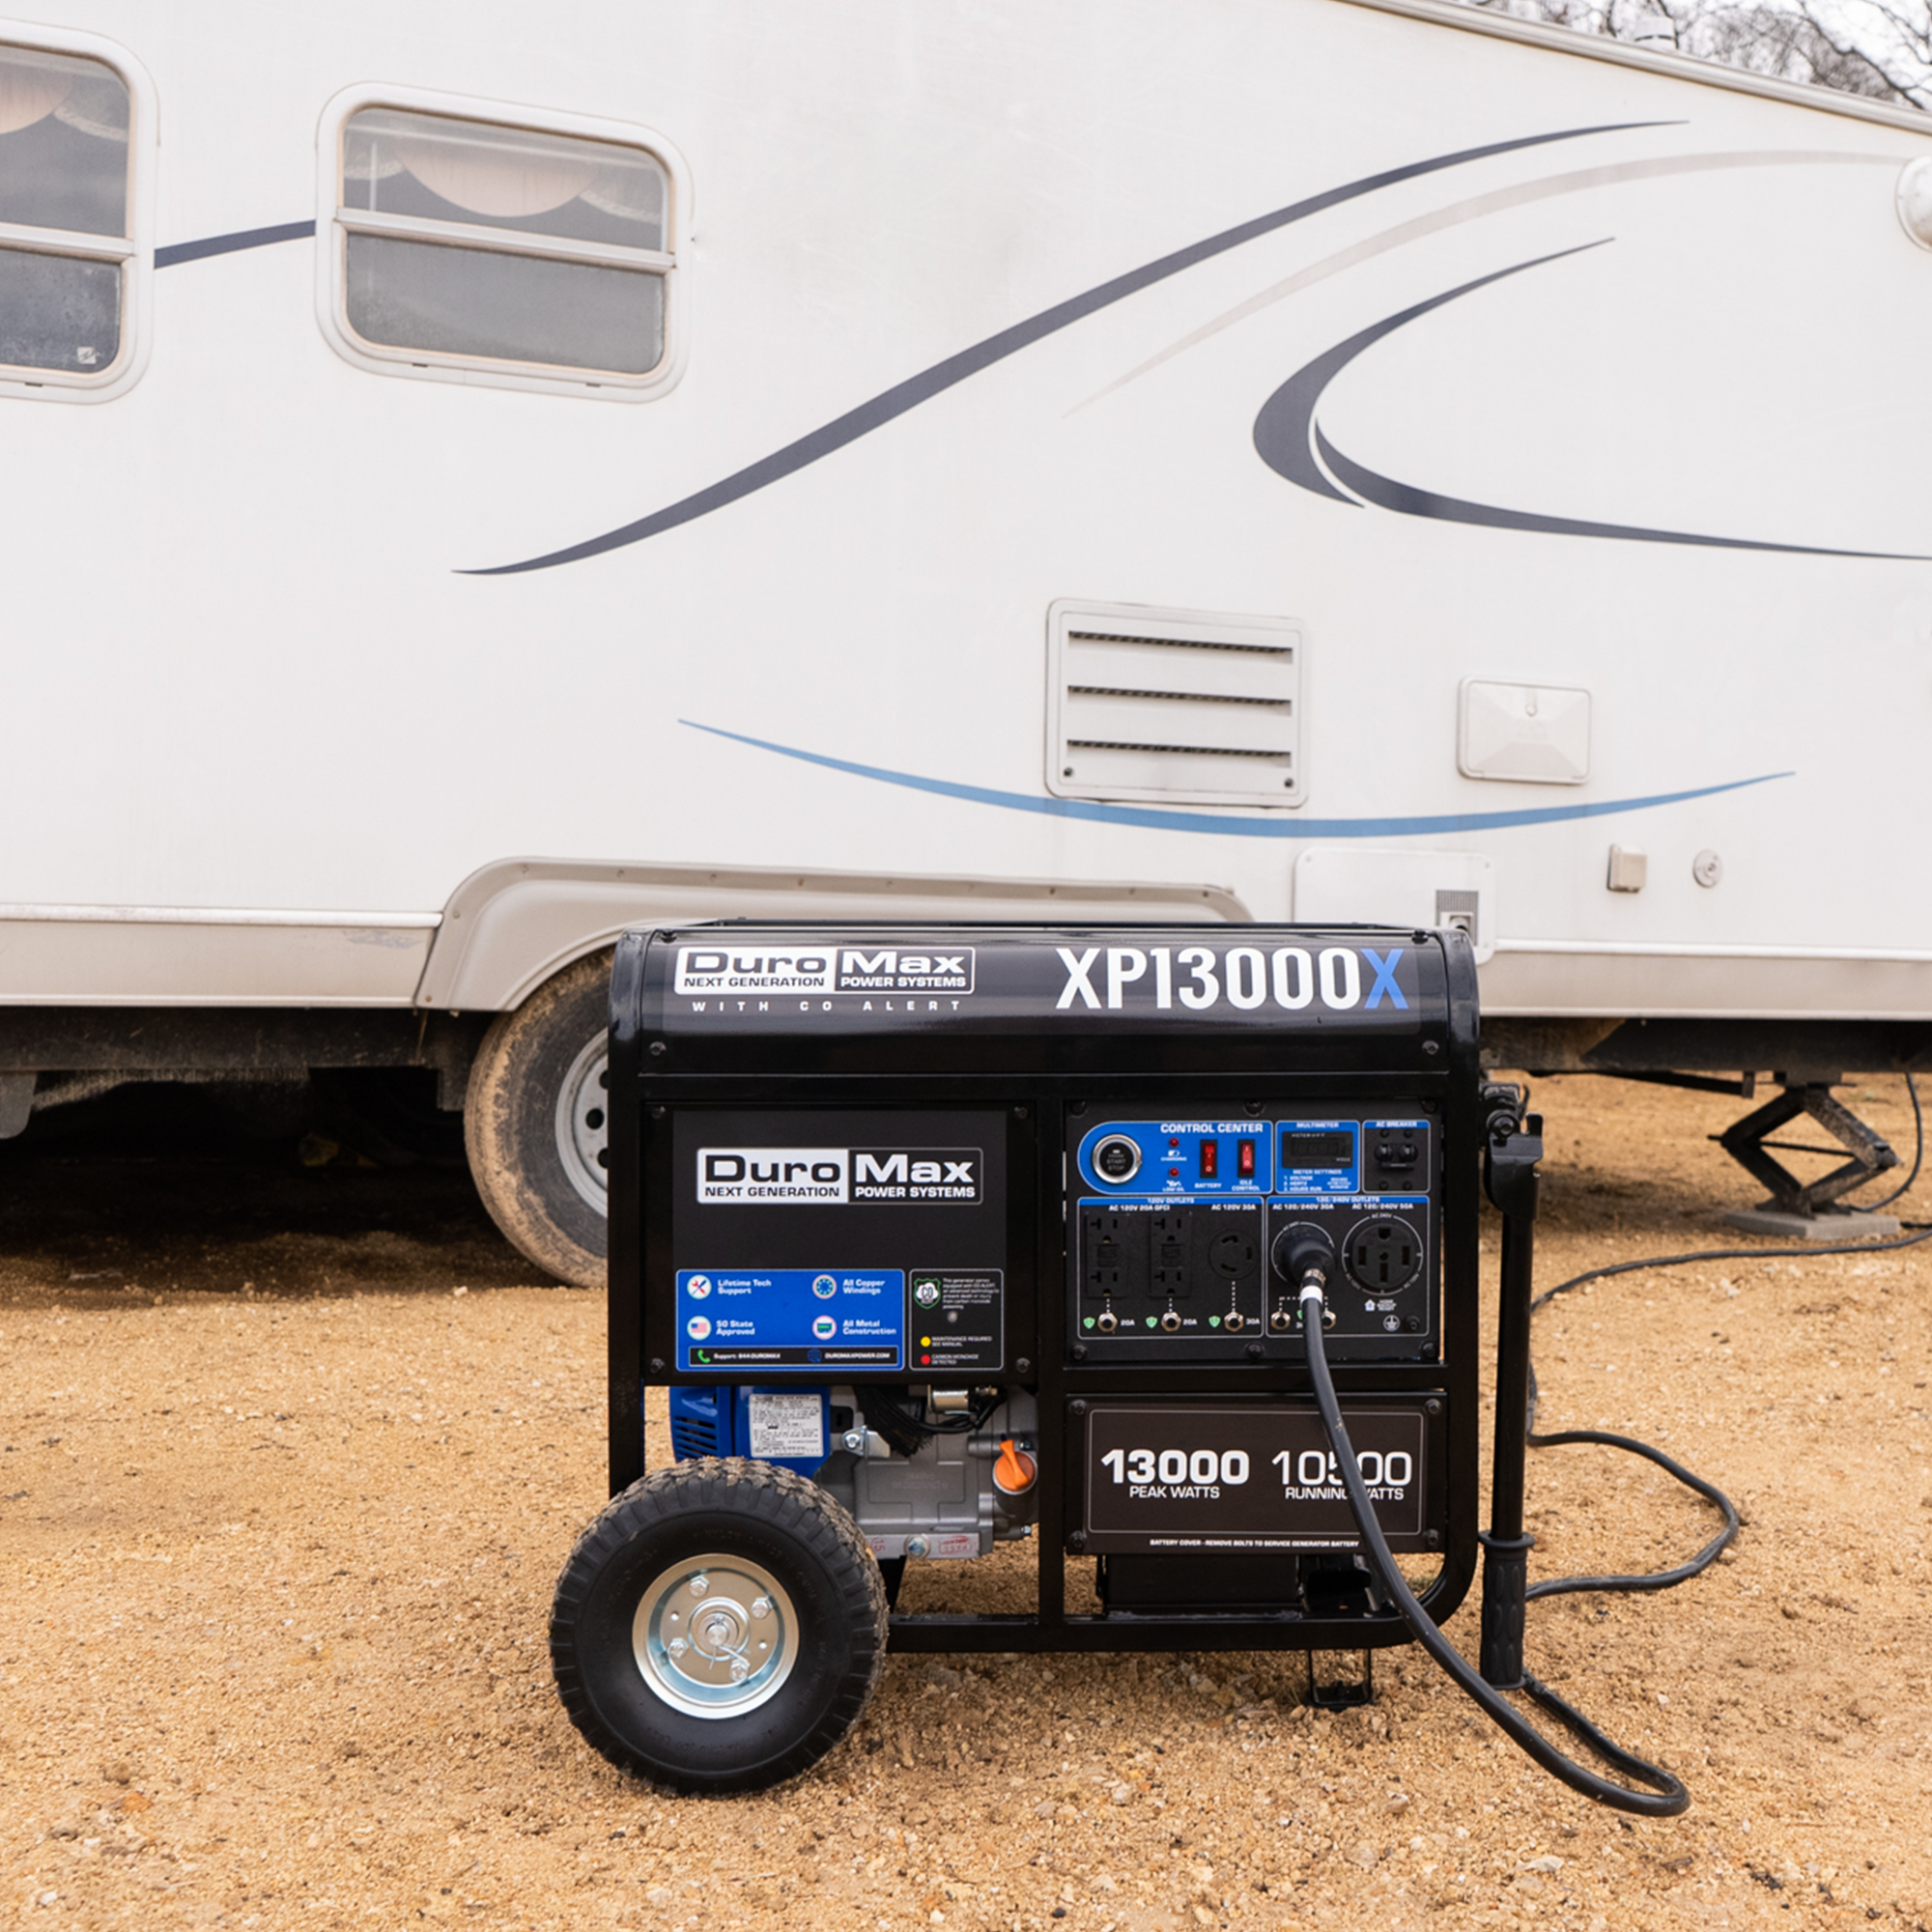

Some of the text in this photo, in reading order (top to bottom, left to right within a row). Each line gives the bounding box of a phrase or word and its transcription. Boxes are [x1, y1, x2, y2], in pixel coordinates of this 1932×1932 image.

[684, 977, 966, 988] NEXT GENERATION POWER SYSTEMS
[1055, 947, 1409, 1010] XP13000X
[692, 1001, 959, 1012] WITH CO ALERT
[1160, 1123, 1263, 1133] CONTROL CENTER
[705, 1187, 976, 1198] NEXT GENERATION POWER SYSTEMS
[855, 1279, 885, 1288] Copper
[718, 1287, 752, 1295] Support
[843, 1287, 881, 1295] Windings
[855, 1319, 881, 1327] Metal
[716, 1328, 755, 1336] Approved
[1100, 1449, 1250, 1485] 13000
[1129, 1486, 1221, 1498] PEAK WATTS
[1367, 1488, 1404, 1500] ATTS
[1291, 1539, 1330, 1548] GENERATOR
